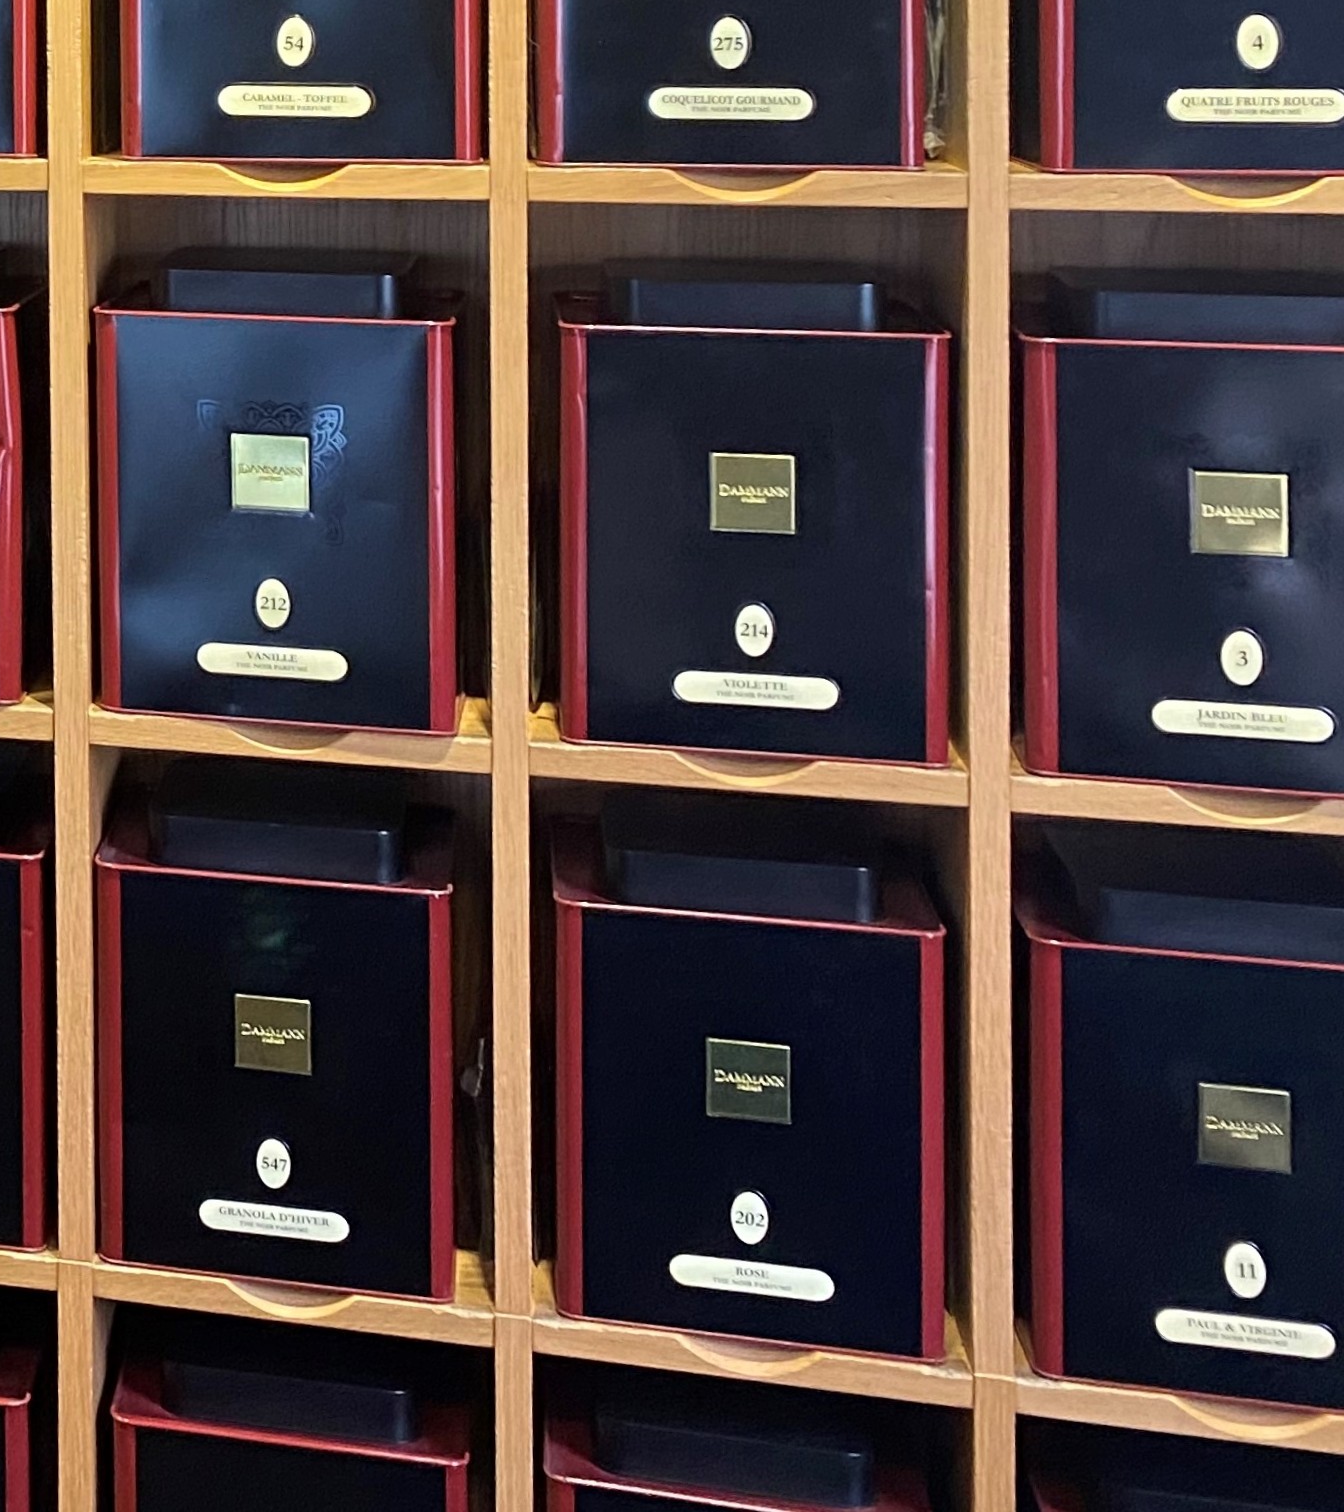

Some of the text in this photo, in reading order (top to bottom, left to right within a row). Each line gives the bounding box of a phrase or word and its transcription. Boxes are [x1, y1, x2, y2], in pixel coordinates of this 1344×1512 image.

[283, 35, 304, 51] 54
[714, 37, 744, 51] 275
[1252, 35, 1264, 51] 4
[242, 92, 348, 104] CARAMEL TOFFEE
[661, 94, 802, 106] COQUELICOT GOURMAND
[1181, 96, 1336, 108] QUATRE FRUITS ROUGES
[260, 596, 287, 611] 212
[740, 622, 769, 638] 214
[245, 651, 299, 663] VANILLE
[1238, 651, 1249, 666] 3
[722, 678, 789, 691] VIOLETTE
[1197, 709, 1288, 723] JARDIN BLEU
[262, 1156, 288, 1172] 547
[218, 1206, 331, 1227] GRANOLA D'HIVER
[735, 1210, 765, 1227] 202
[735, 1267, 770, 1279] ROSE
[1238, 1262, 1257, 1280] 11
[1186, 1317, 1304, 1339] PAUL & VIRGINIE
